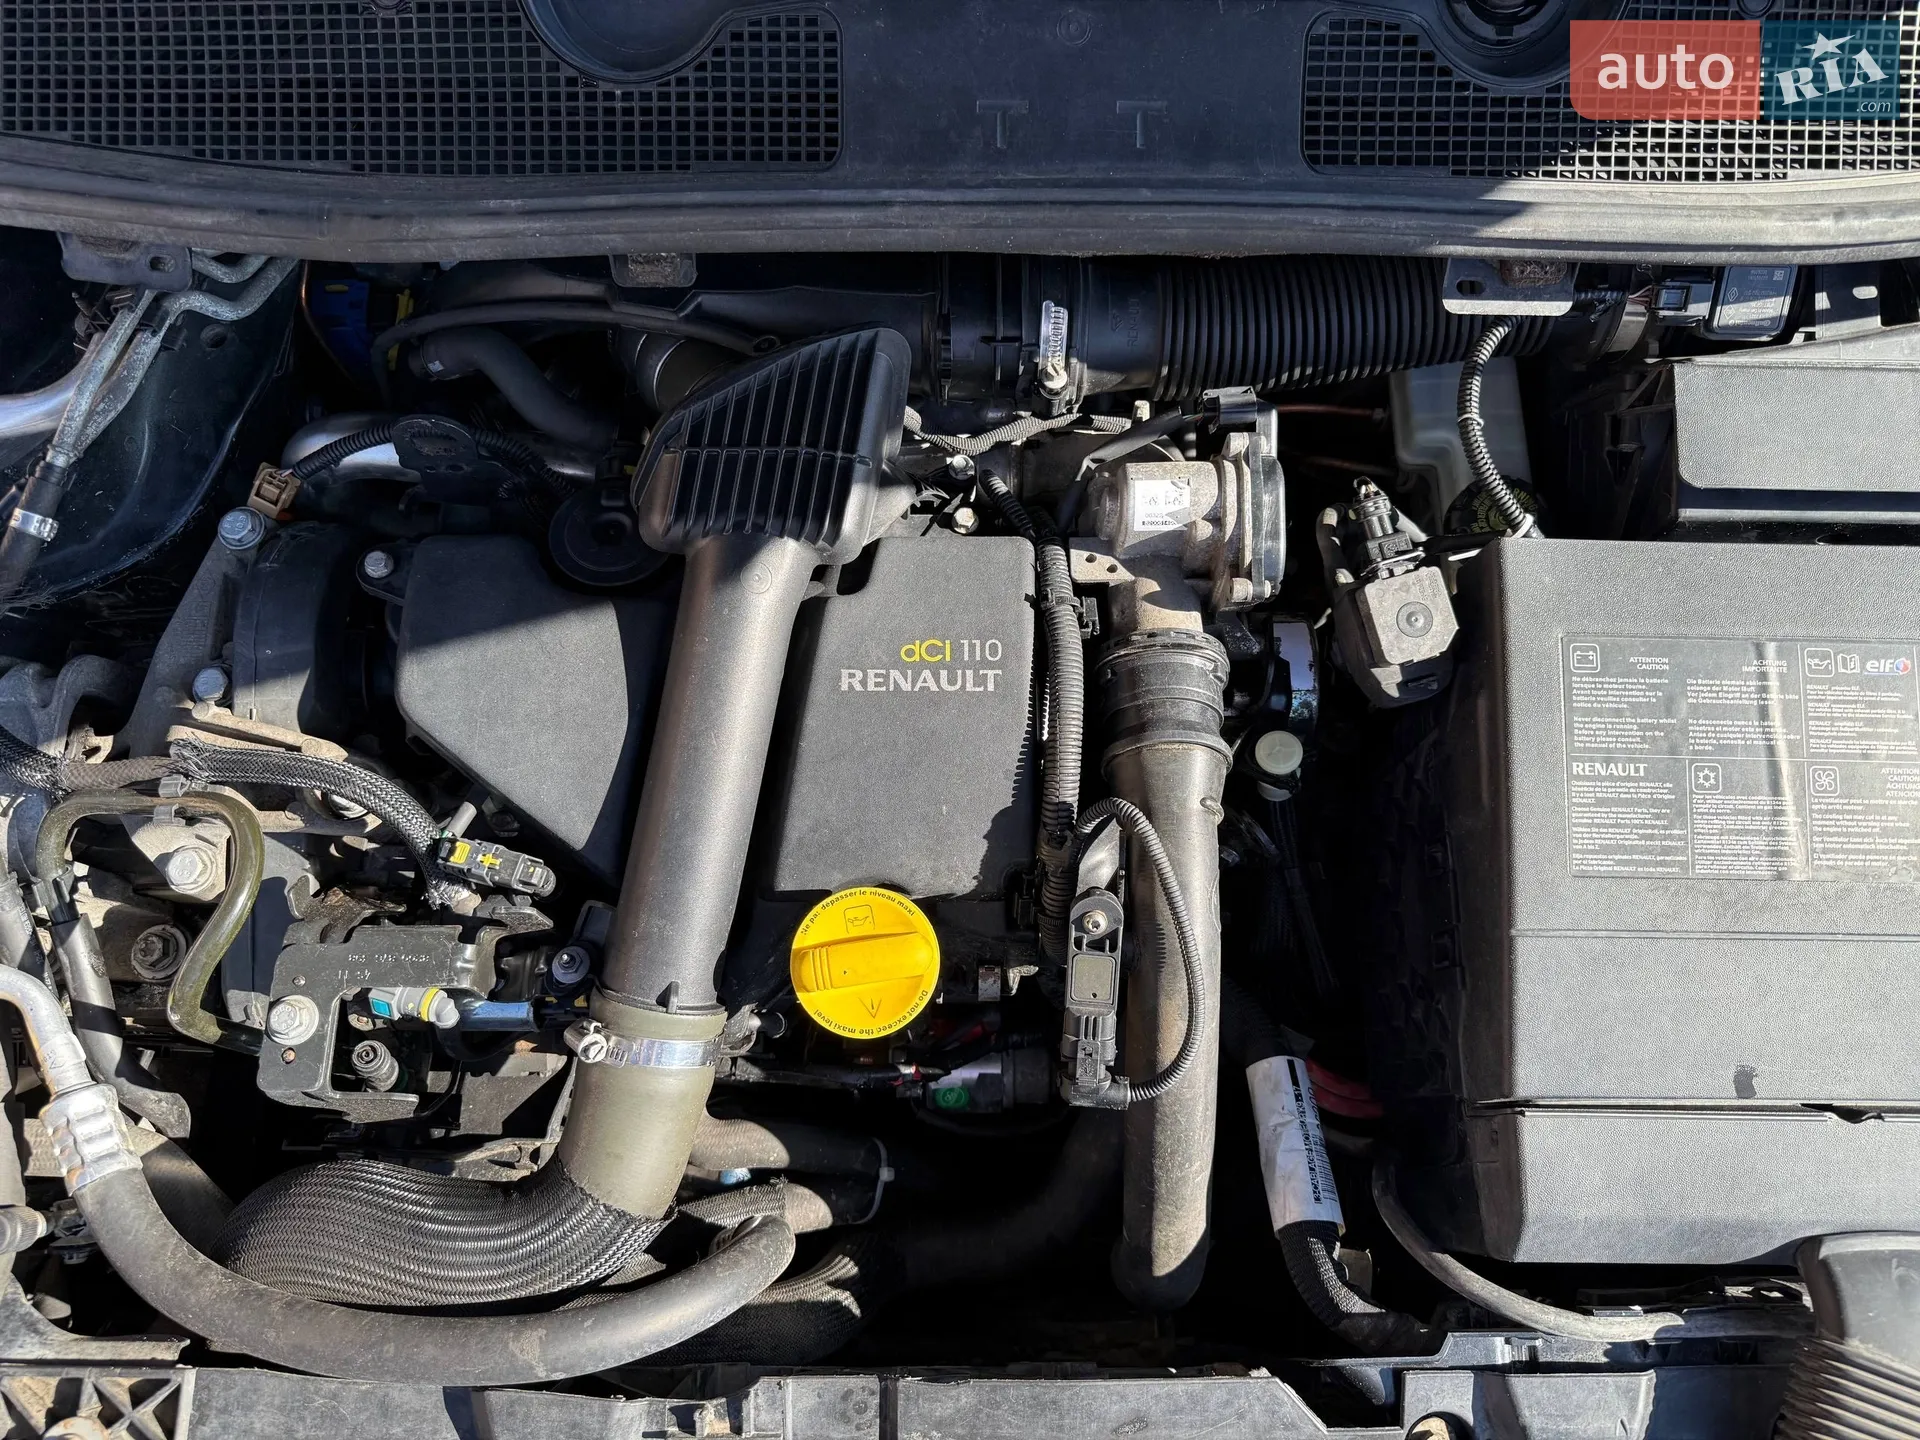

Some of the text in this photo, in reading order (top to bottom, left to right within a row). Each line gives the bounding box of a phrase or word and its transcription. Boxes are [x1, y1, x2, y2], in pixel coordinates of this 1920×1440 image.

[960, 639, 1002, 661] 110
[1866, 658, 1894, 673] elf
[840, 669, 1002, 692] RENAULT
[1572, 763, 1648, 776] RENAULT
[870, 890, 897, 903] niveau
[897, 900, 915, 916] maxi
[918, 989, 928, 1003] Do
[906, 1002, 919, 1017] not
[813, 1009, 833, 1027] level
[833, 1023, 856, 1034] maxi
